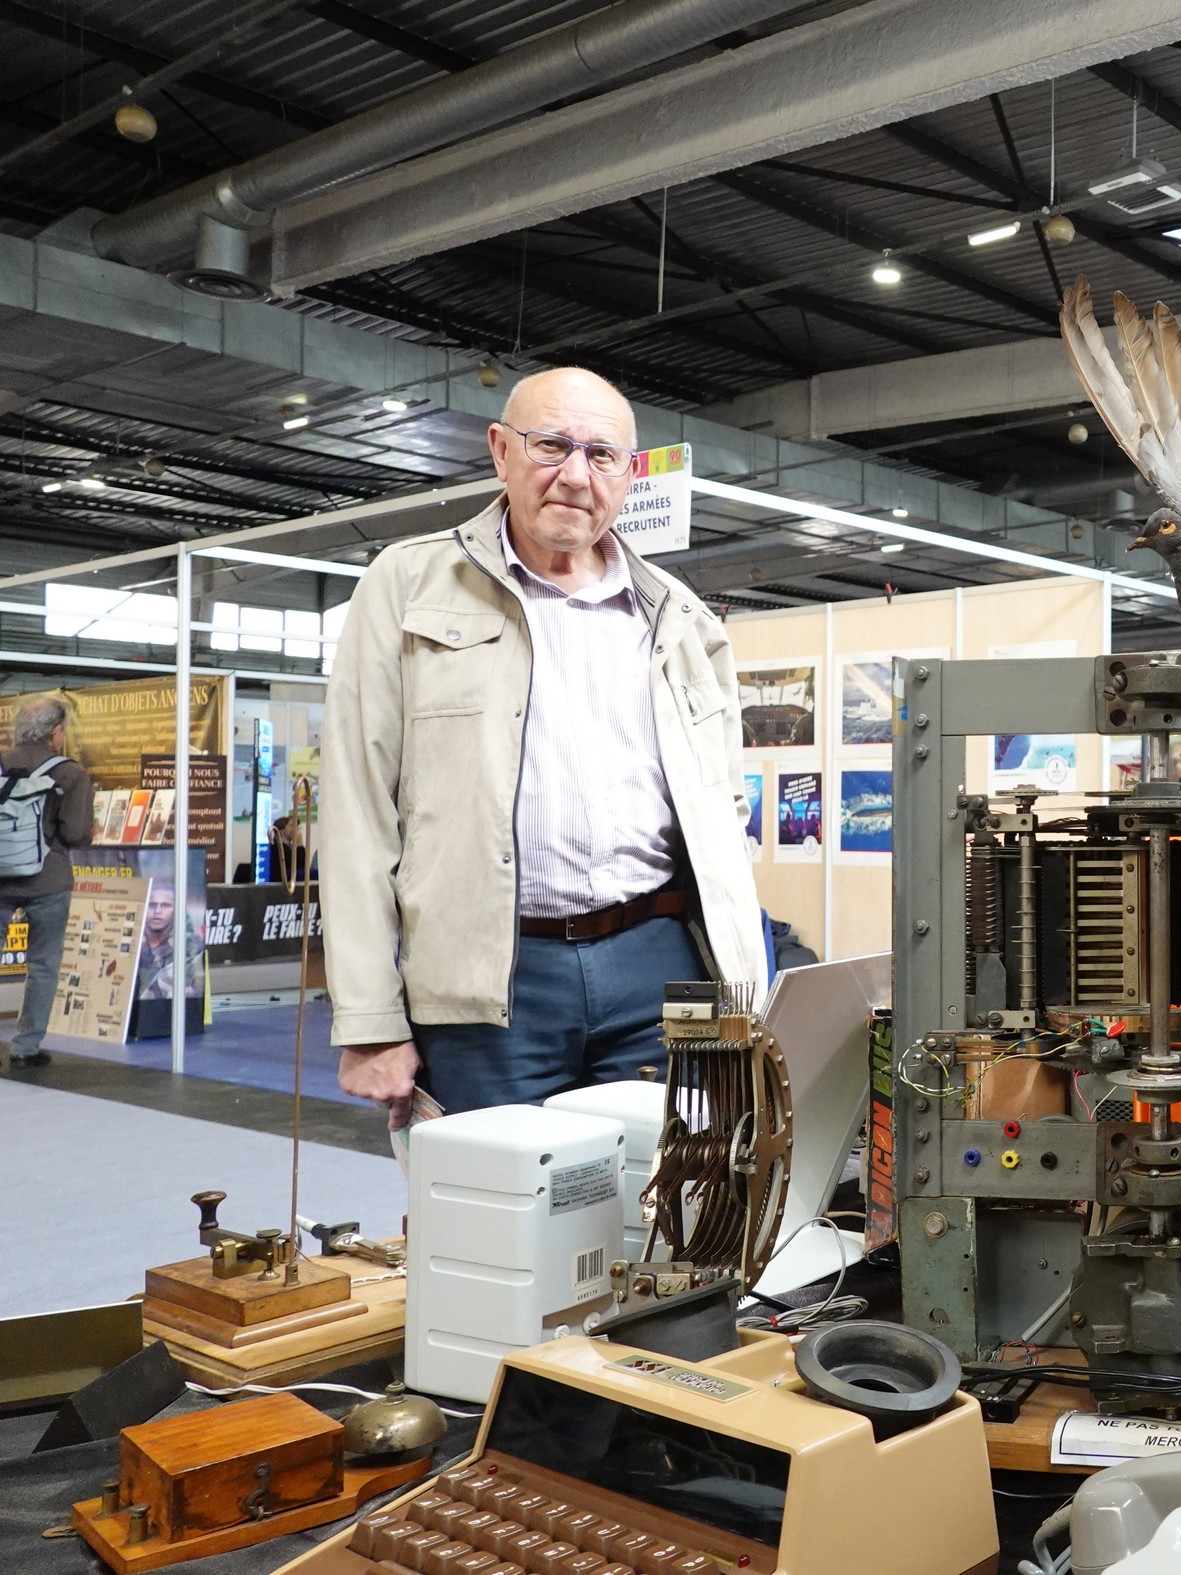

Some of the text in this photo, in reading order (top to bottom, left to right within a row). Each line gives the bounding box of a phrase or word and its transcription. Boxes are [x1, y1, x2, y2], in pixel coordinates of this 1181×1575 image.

[627, 481, 651, 495] IRFA
[632, 496, 671, 513] ARMÉES
[617, 515, 671, 533] RECRUTENT
[111, 690, 157, 713] D'OBJETS
[158, 685, 209, 709] ANENS
[144, 768, 192, 778] POURQI
[195, 769, 219, 777] NOUS
[142, 779, 223, 788] FAIRE CFIANCE
[263, 922, 280, 940] LE
[1098, 1419, 1159, 1430] NE PAS
